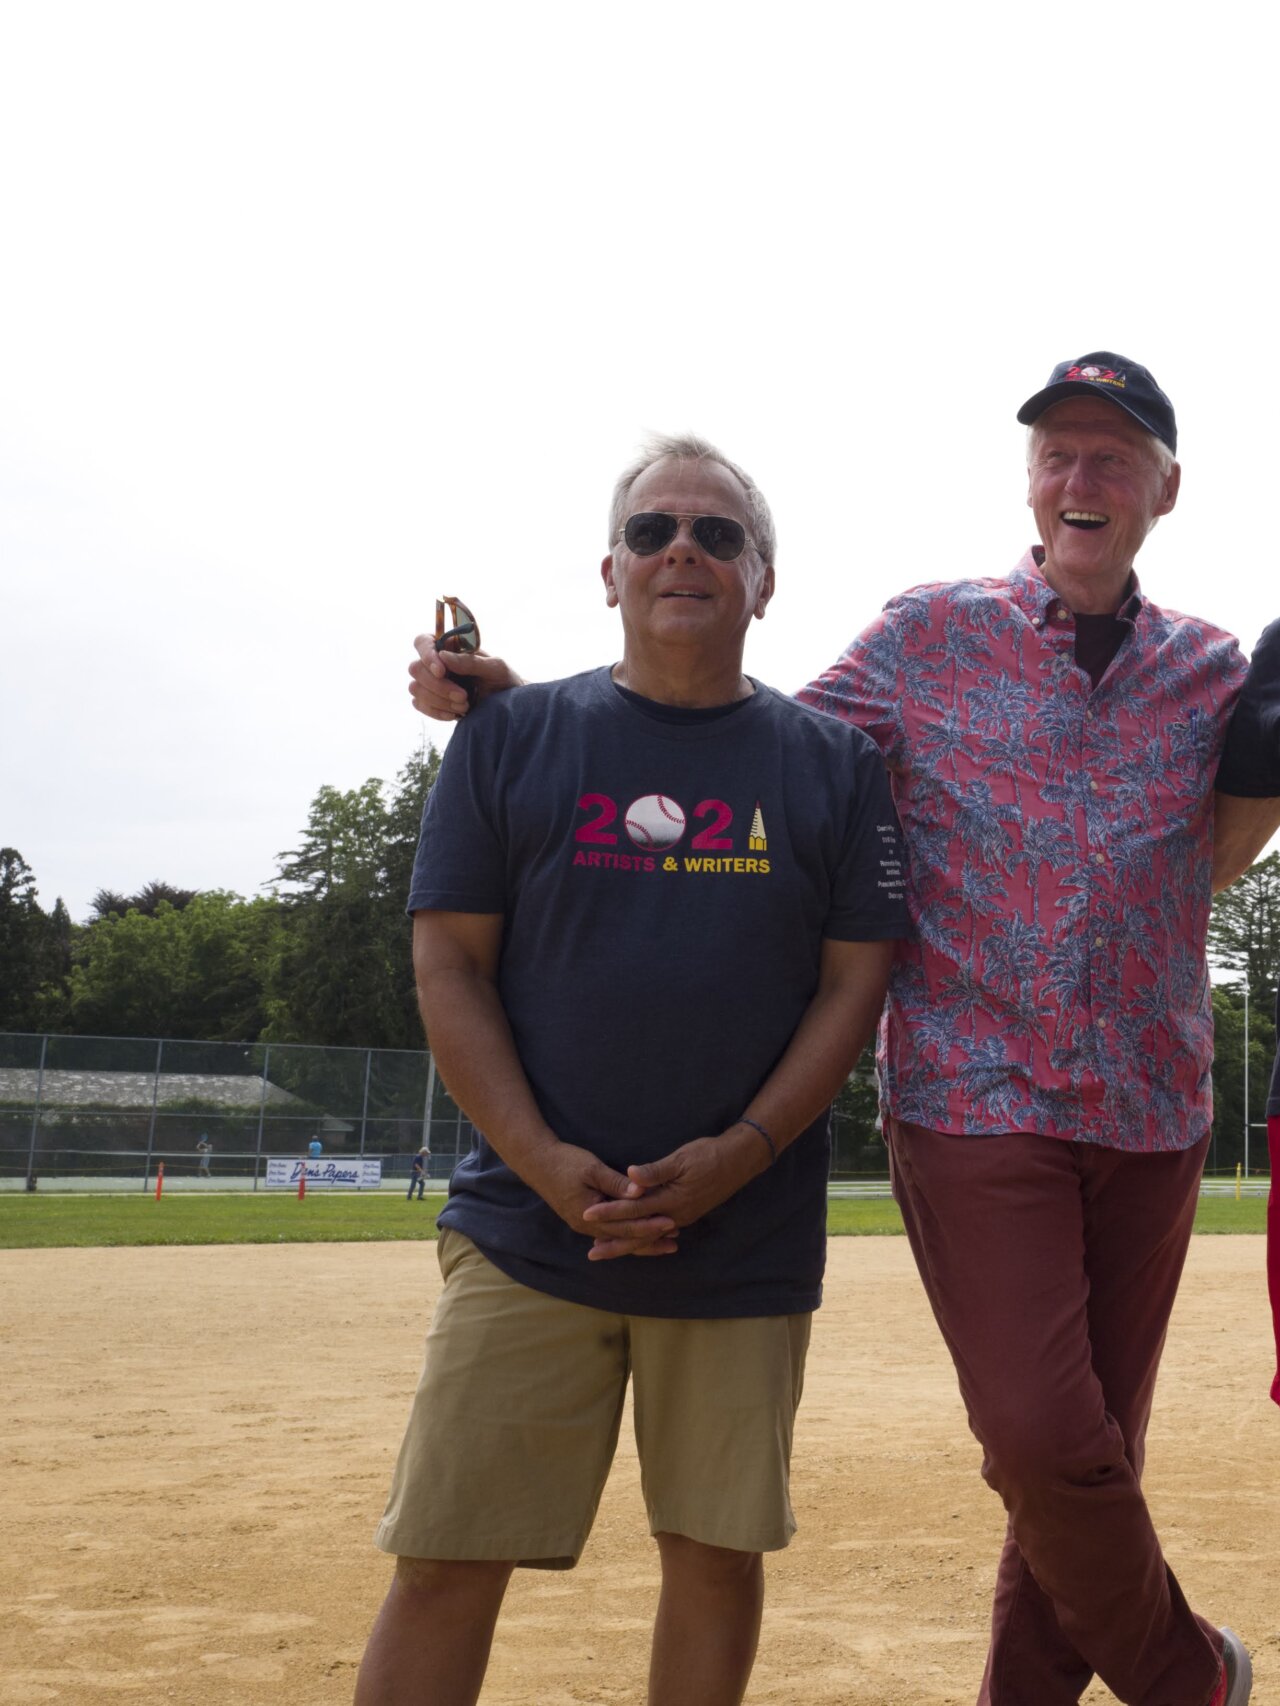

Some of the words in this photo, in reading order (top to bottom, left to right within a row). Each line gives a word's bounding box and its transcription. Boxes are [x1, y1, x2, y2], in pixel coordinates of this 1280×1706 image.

[573, 851, 655, 871] ARTISTS
[662, 856, 679, 872] &
[684, 857, 771, 874] WRITERS
[323, 1163, 359, 1184] Papers
